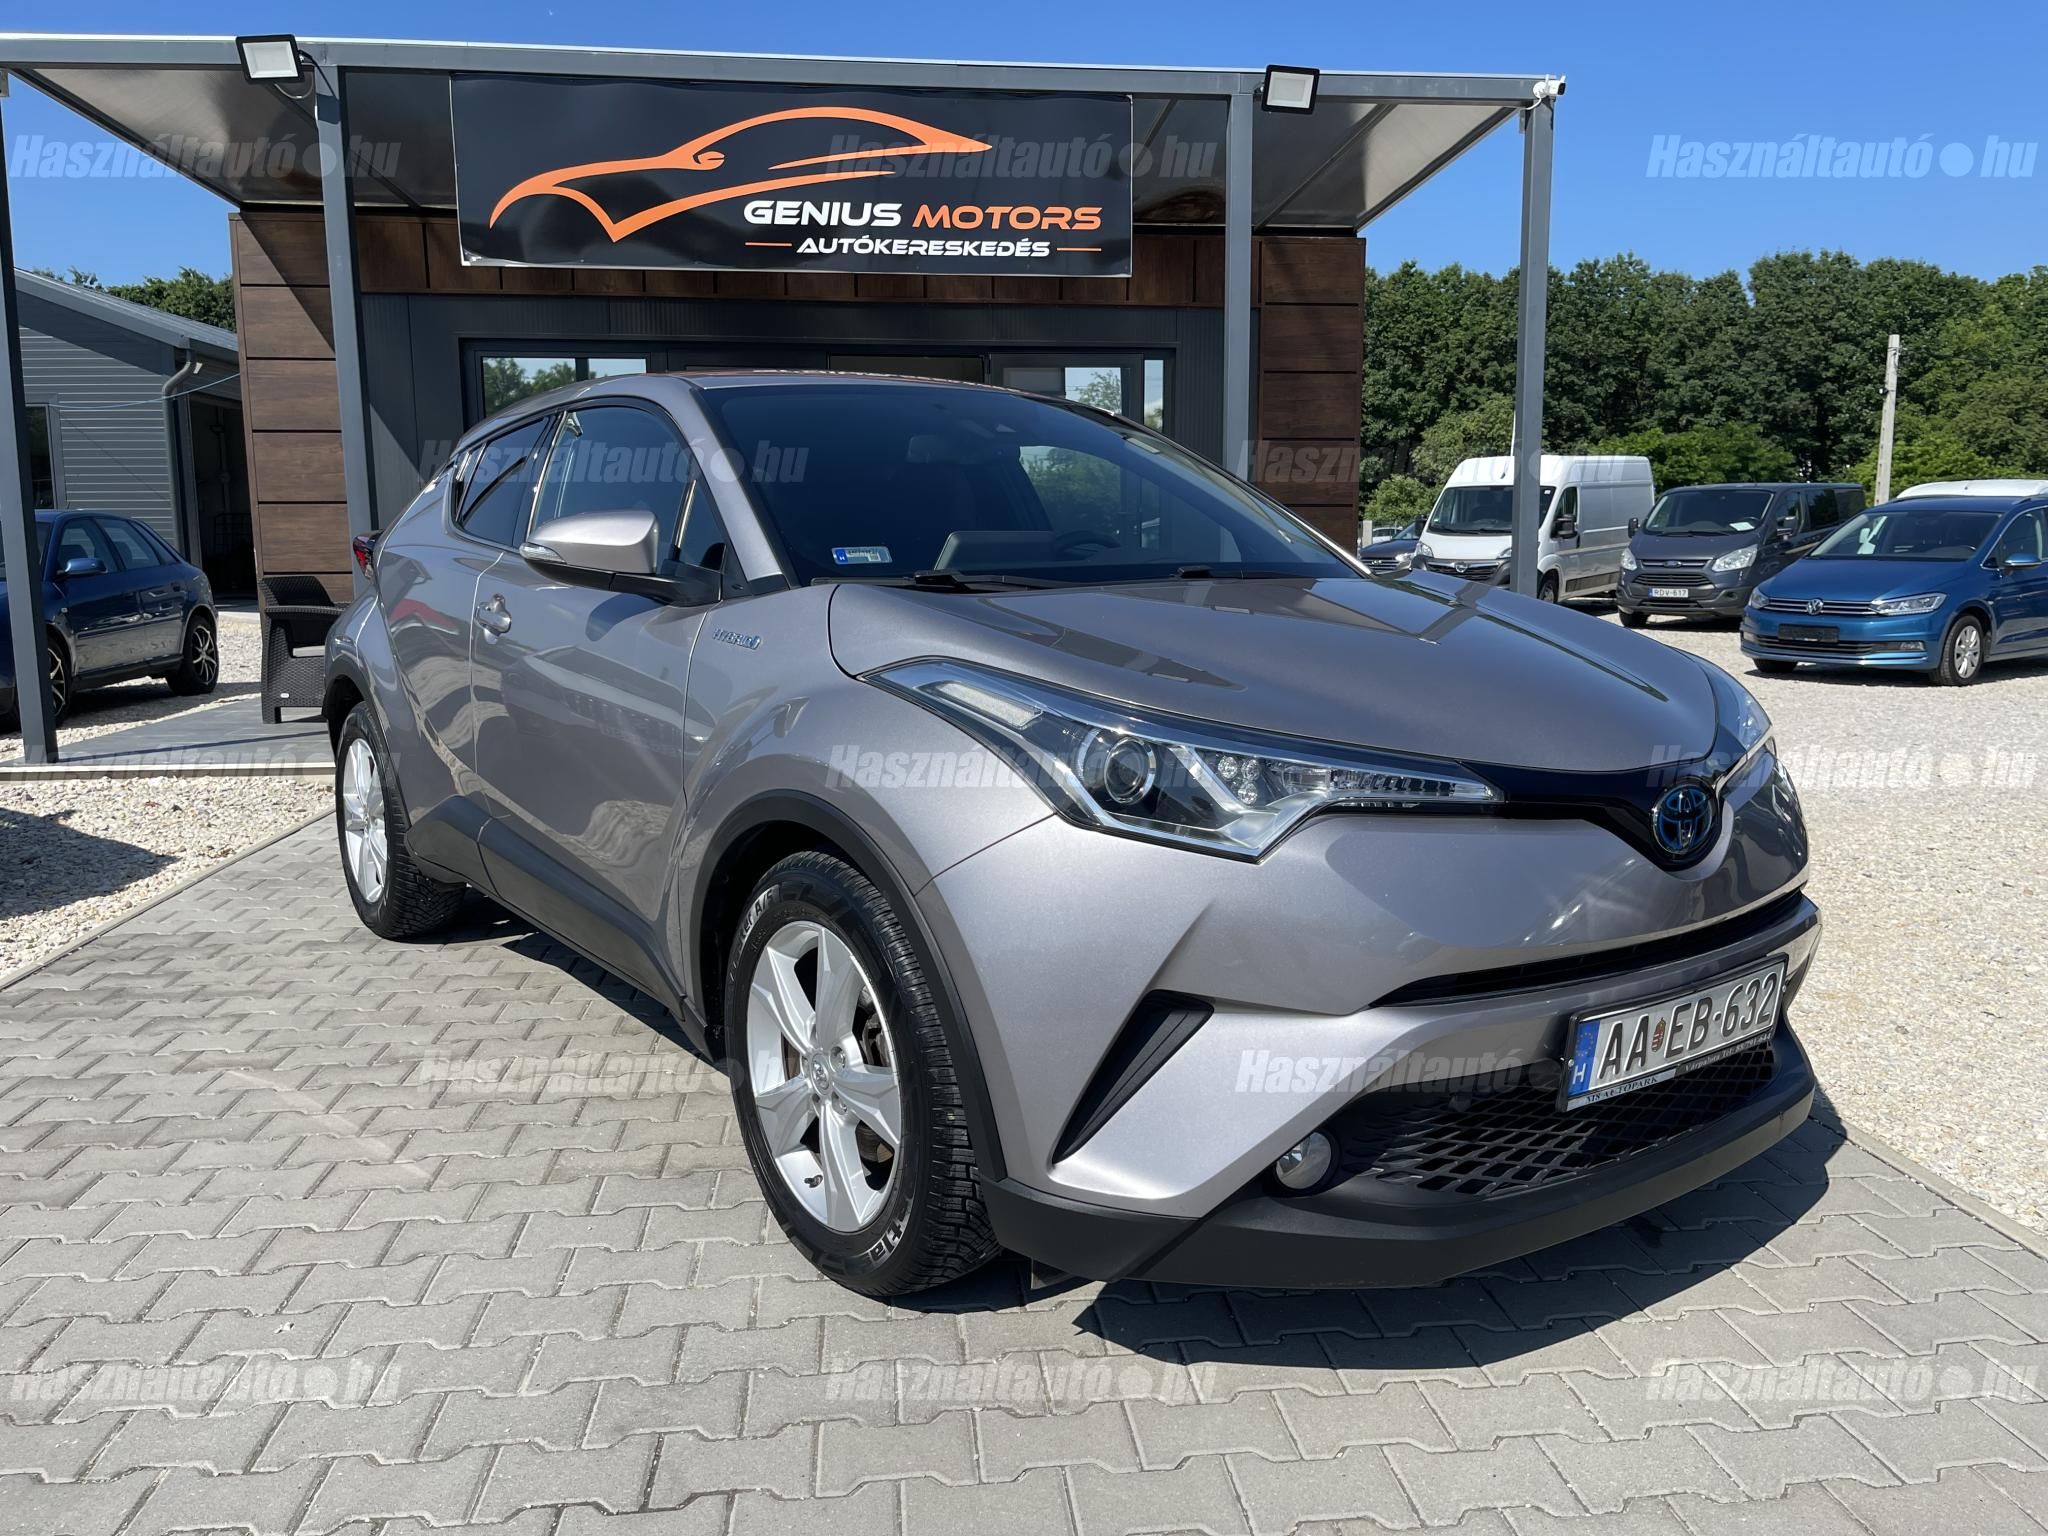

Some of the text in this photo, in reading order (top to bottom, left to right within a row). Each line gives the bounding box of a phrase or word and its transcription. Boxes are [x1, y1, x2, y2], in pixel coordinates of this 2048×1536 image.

[744, 200, 1102, 230] GENIUS MOTORS
[796, 235, 1050, 257] AUTÓKERESKEDÉS
[1572, 972, 1777, 1084] H AA EB-632
